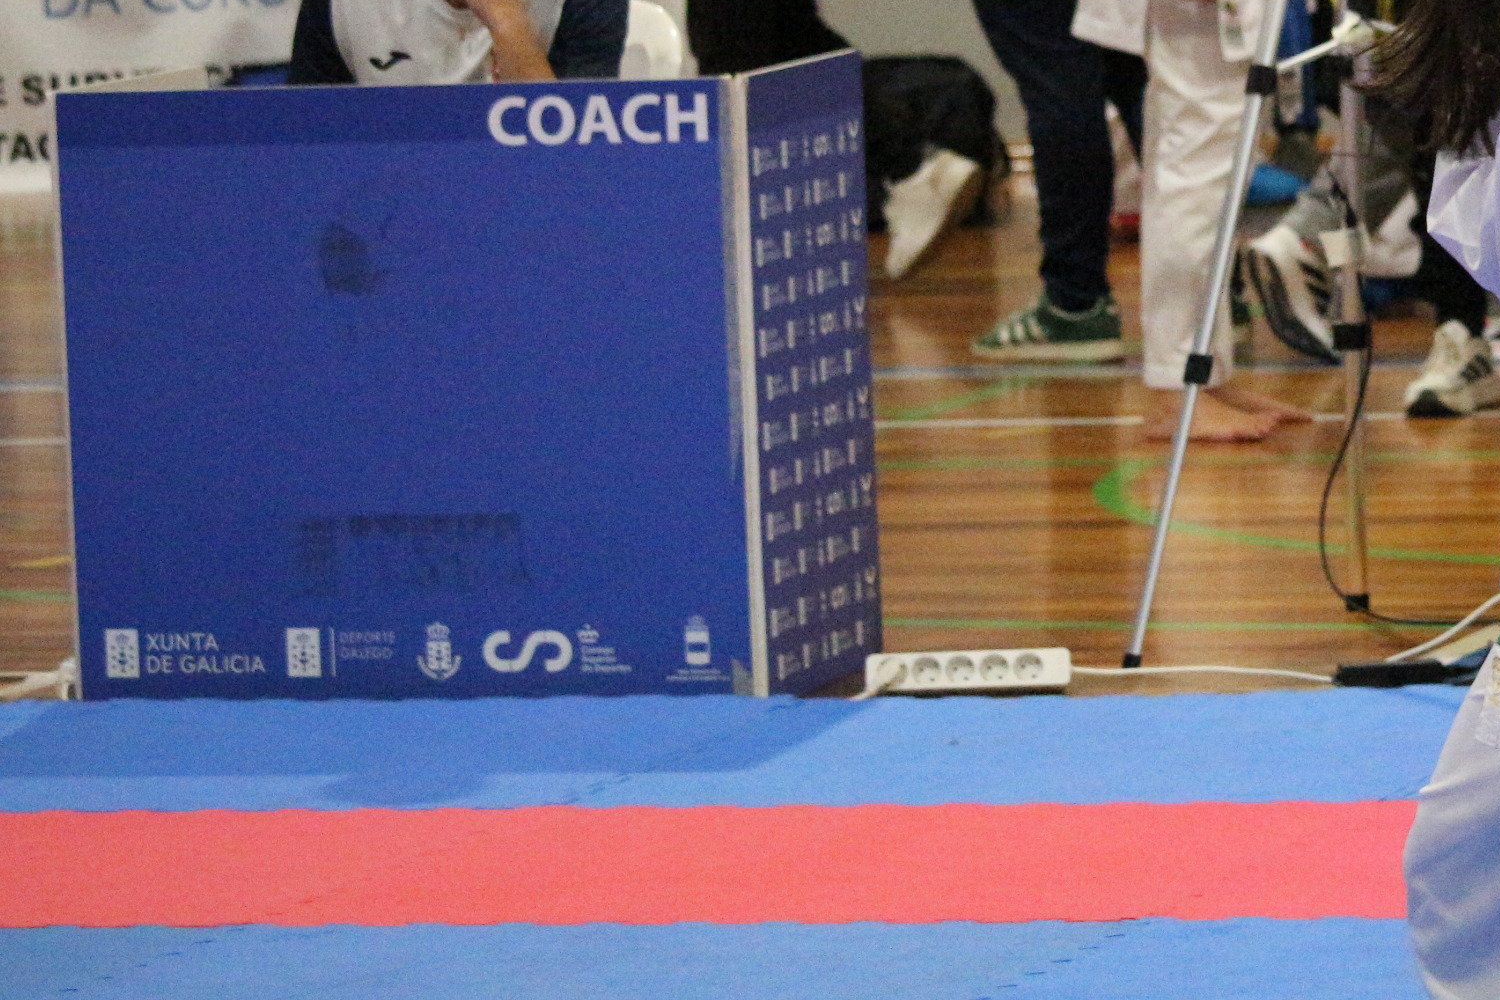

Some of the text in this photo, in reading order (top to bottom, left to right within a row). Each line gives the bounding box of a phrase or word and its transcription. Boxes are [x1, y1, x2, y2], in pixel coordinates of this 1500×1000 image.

[488, 93, 710, 147] COACH
[145, 632, 220, 652] XUNTA
[145, 654, 266, 675] DE GALICIA
